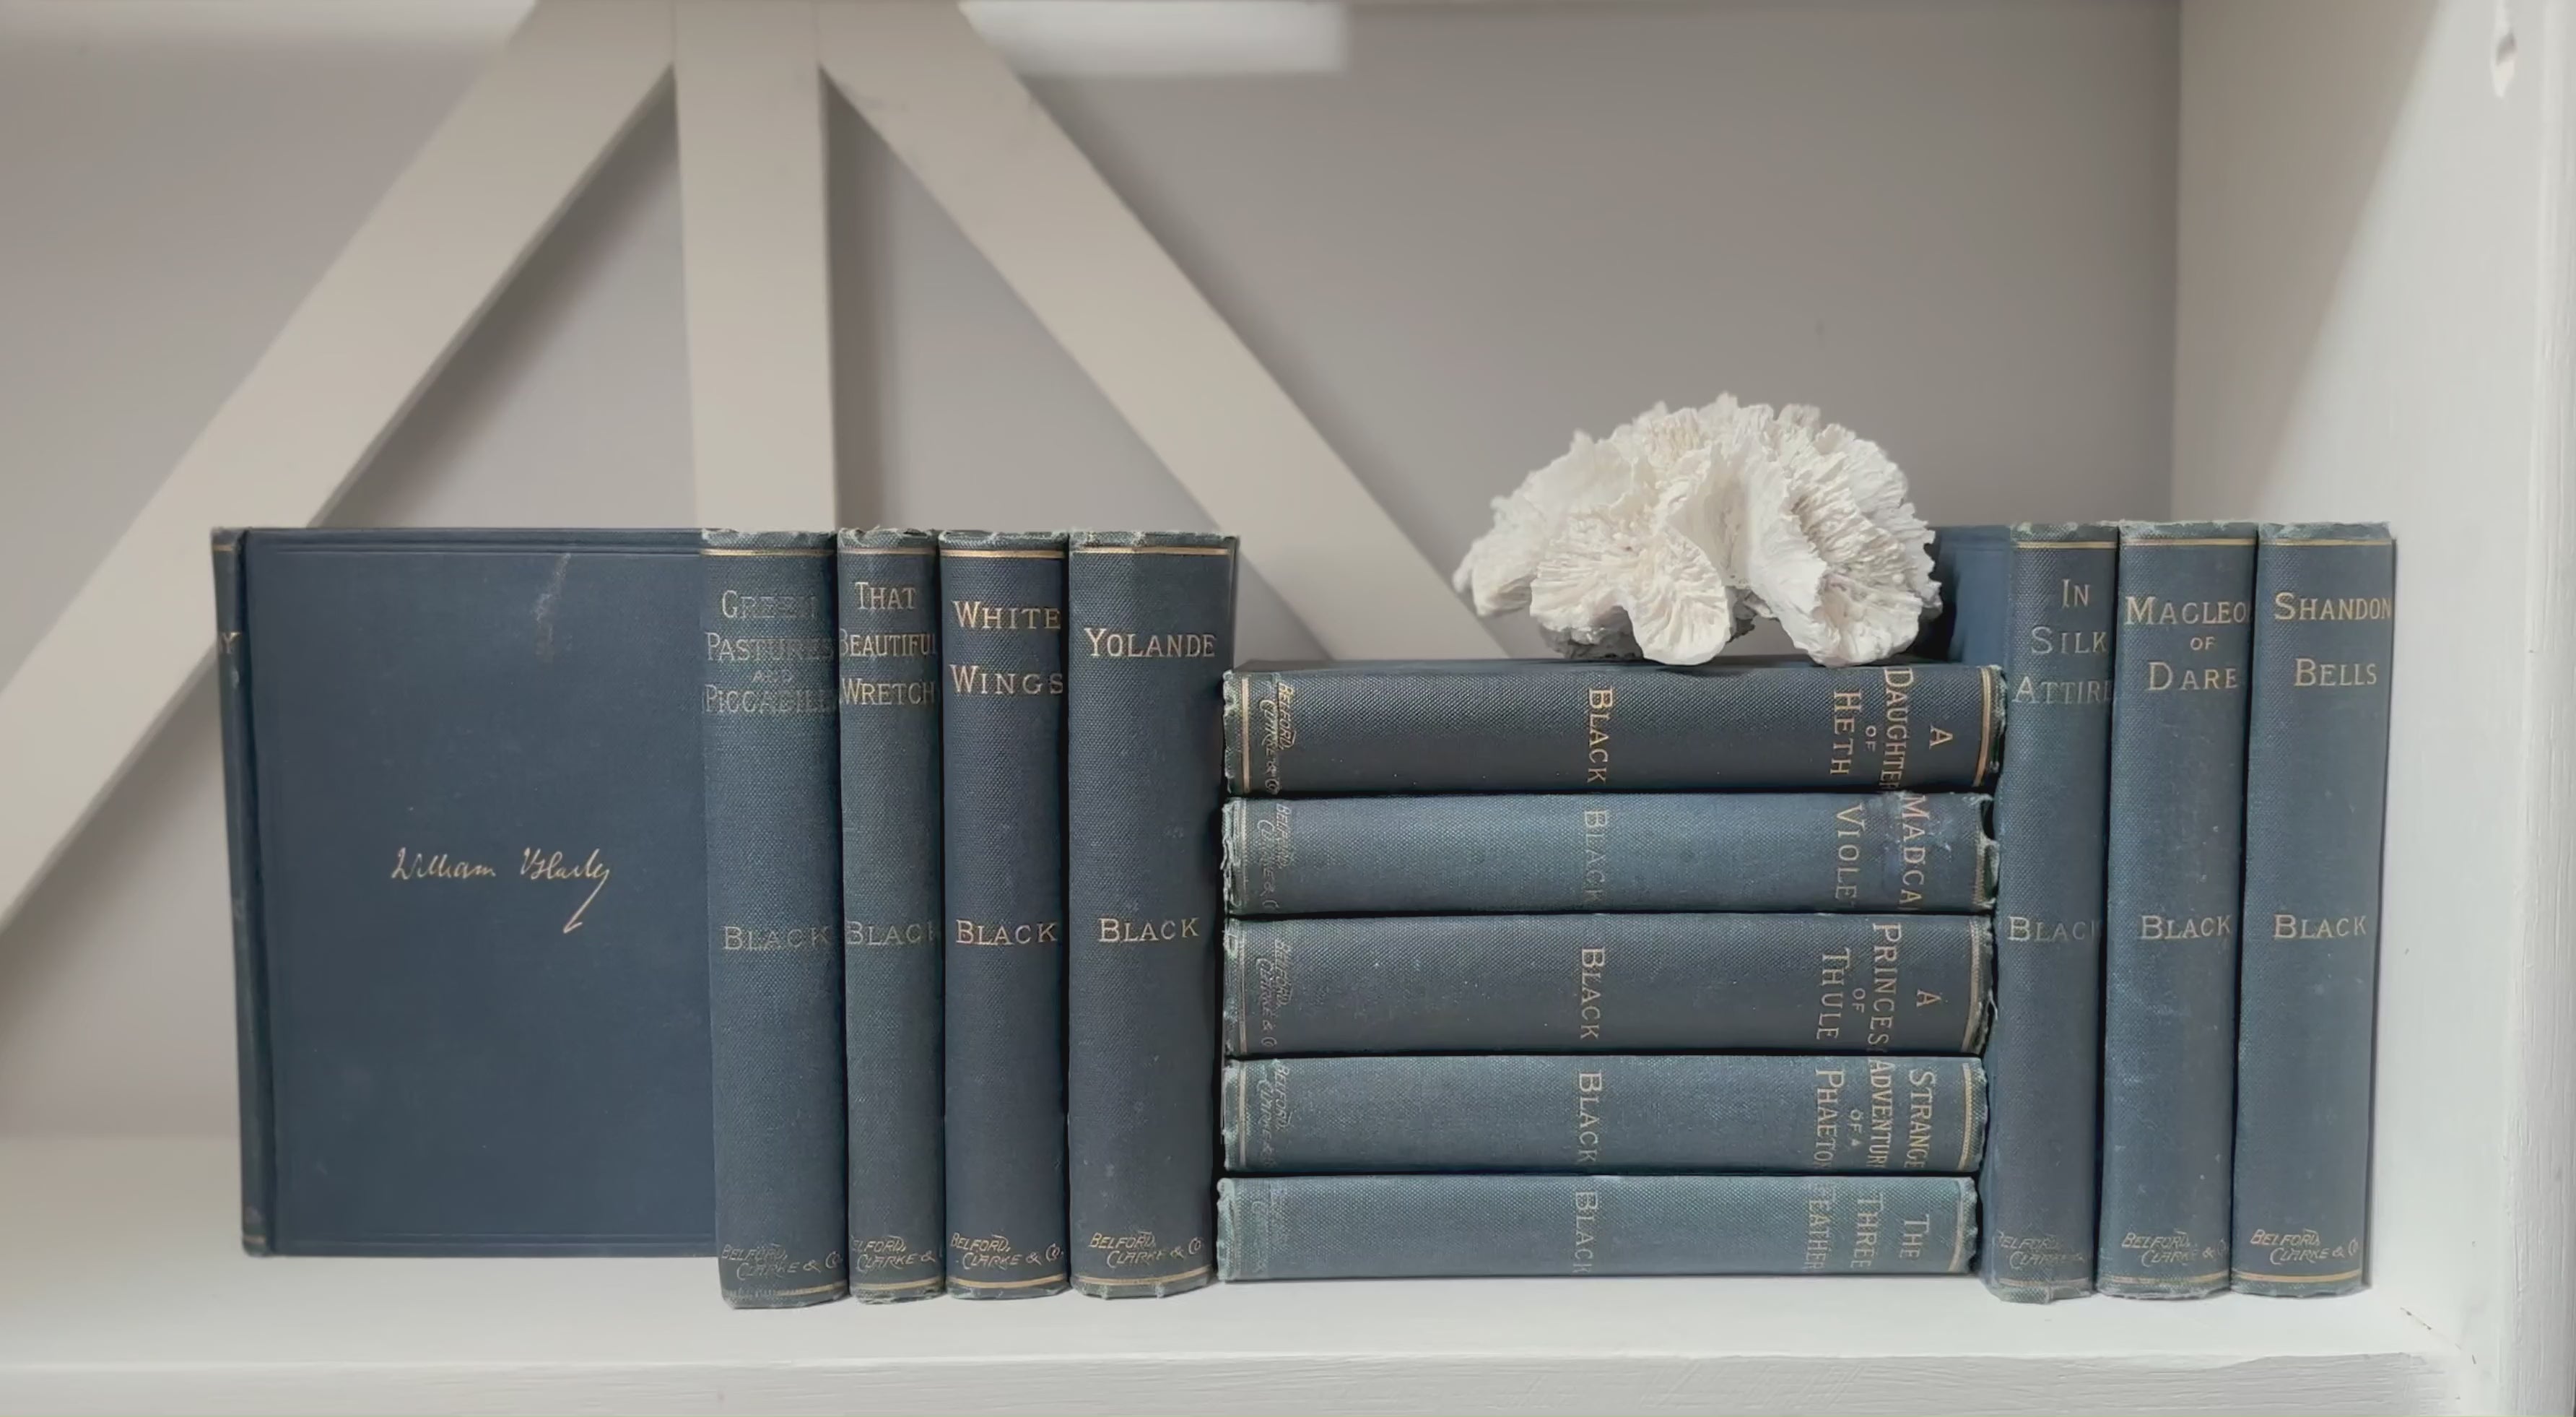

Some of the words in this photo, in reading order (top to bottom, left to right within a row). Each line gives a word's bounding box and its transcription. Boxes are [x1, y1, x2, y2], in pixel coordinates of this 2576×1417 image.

[855, 581, 915, 610] THAT
[2062, 578, 2089, 608] IN
[2275, 592, 2392, 620] SHANDON
[952, 600, 1061, 629] WHITE
[2124, 596, 2250, 625] MACLEO
[1084, 628, 1217, 658] YOLANDE
[2030, 626, 2108, 654] SILK
[2190, 636, 2215, 651] OF
[951, 664, 1063, 695] WINGS
[2146, 661, 2239, 691] DARE
[2294, 658, 2377, 686] BELLS
[840, 677, 935, 706] WRETCH
[1588, 687, 1614, 783] BLACK
[1830, 689, 1863, 775] HETH
[1865, 725, 1877, 752] OF
[1929, 724, 1953, 749] A
[391, 847, 496, 879] William
[1835, 805, 1865, 907] VIOLE
[1897, 794, 1930, 909] MADCA
[722, 926, 830, 950] BLACK
[955, 919, 1058, 945] BLACK
[1099, 918, 1200, 942] BLACK
[2141, 914, 2232, 940] BLACK
[2273, 914, 2367, 939] BLACK
[1580, 948, 1606, 1040] BLACK
[1816, 948, 1851, 1040] THULE
[1852, 987, 1866, 1013] OF
[1866, 922, 1902, 1054] PRINCES
[1917, 989, 1943, 1008] A
[1577, 1071, 1603, 1164] BLACK
[1849, 1109, 1863, 1135] OF
[850, 1234, 907, 1252] ELFORD,
[1850, 1193, 1884, 1269] THREE
[1899, 1213, 1931, 1258] THE
[921, 1250, 936, 1262] &
[1025, 1250, 1043, 1266] &
[2202, 1246, 2215, 1259] &
[2332, 1245, 2346, 1259] &
[803, 1260, 821, 1273] &
